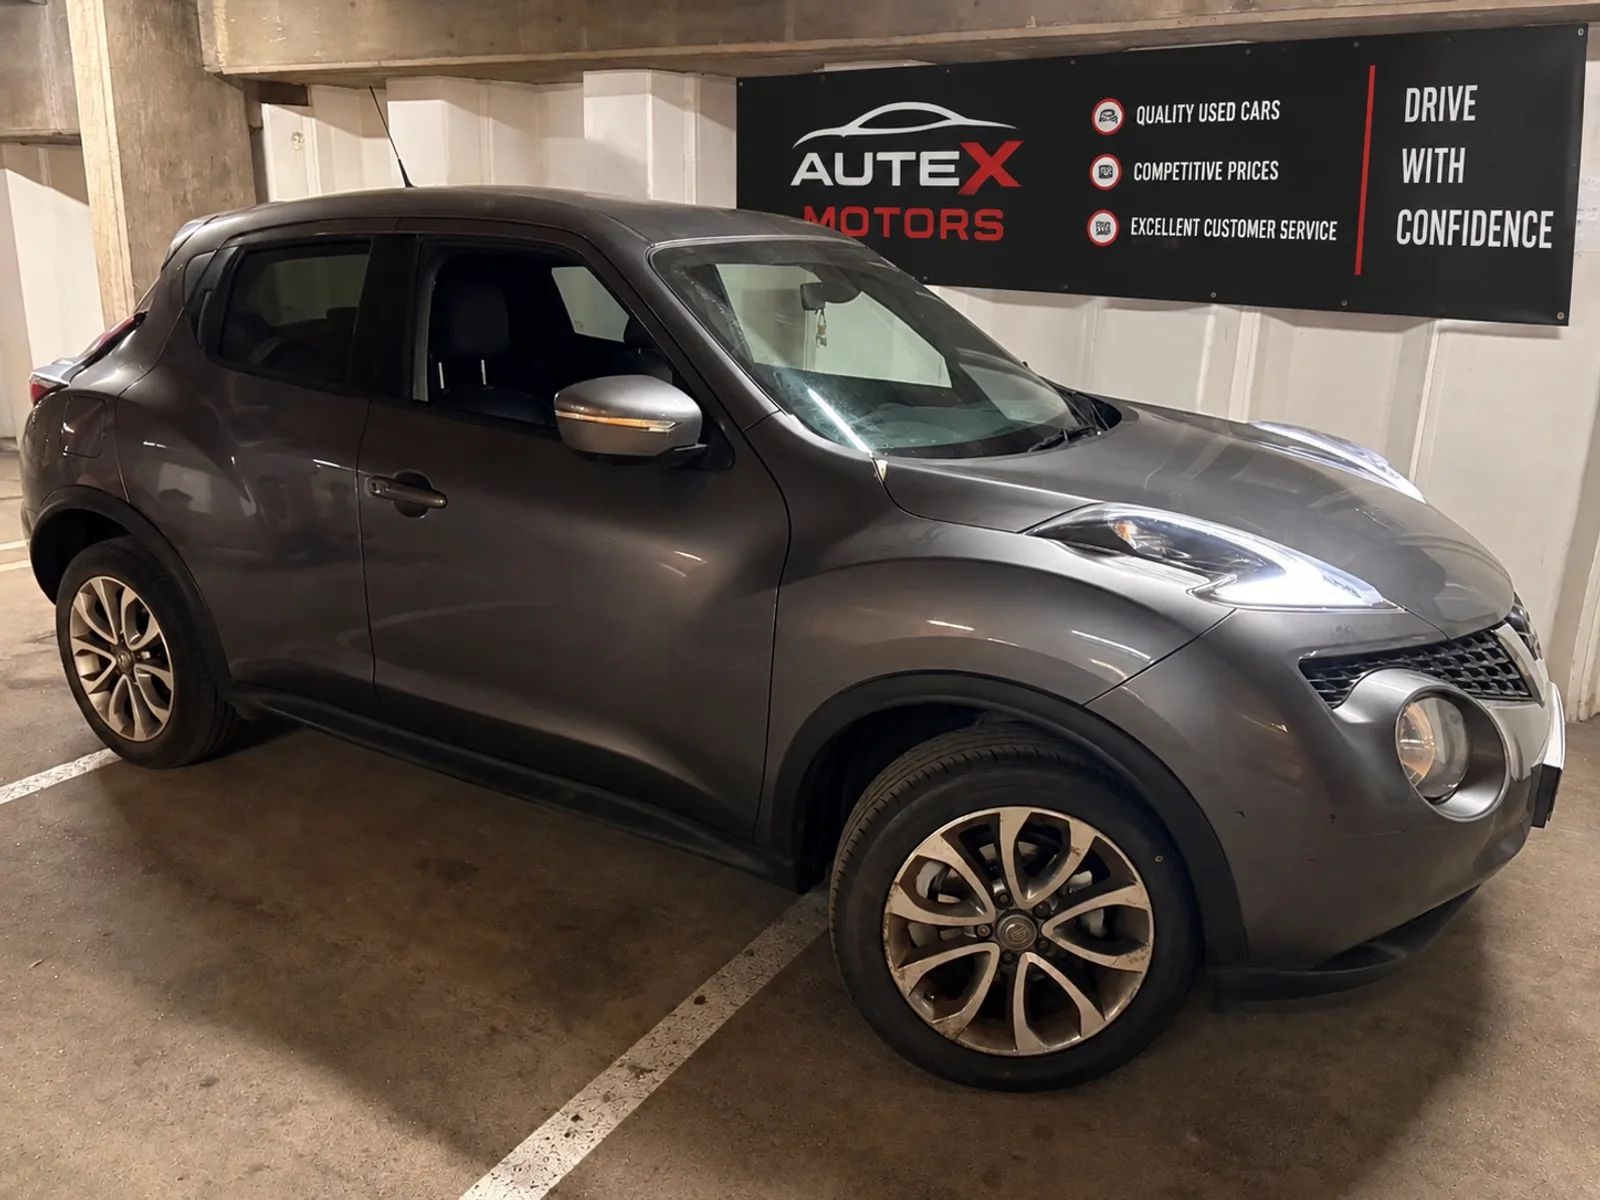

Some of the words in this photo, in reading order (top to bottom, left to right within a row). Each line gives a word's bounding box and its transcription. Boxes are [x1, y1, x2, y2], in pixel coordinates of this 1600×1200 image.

[1136, 104, 1195, 126] QUALITY
[1198, 101, 1236, 122] USED
[1240, 100, 1281, 121] CARS
[1404, 85, 1478, 122] DRIVE
[790, 140, 1025, 196] AUTEX
[1133, 161, 1223, 181] COMPETITIVE
[1227, 160, 1280, 180] PRICES
[1402, 147, 1466, 184] WITH
[803, 205, 1005, 241] MOTORS
[1130, 217, 1200, 236] EXCELLENT
[1203, 218, 1276, 239] CUSTOMER
[1279, 220, 1338, 241] SERVICE
[1396, 208, 1555, 249] CONFIDENCE
